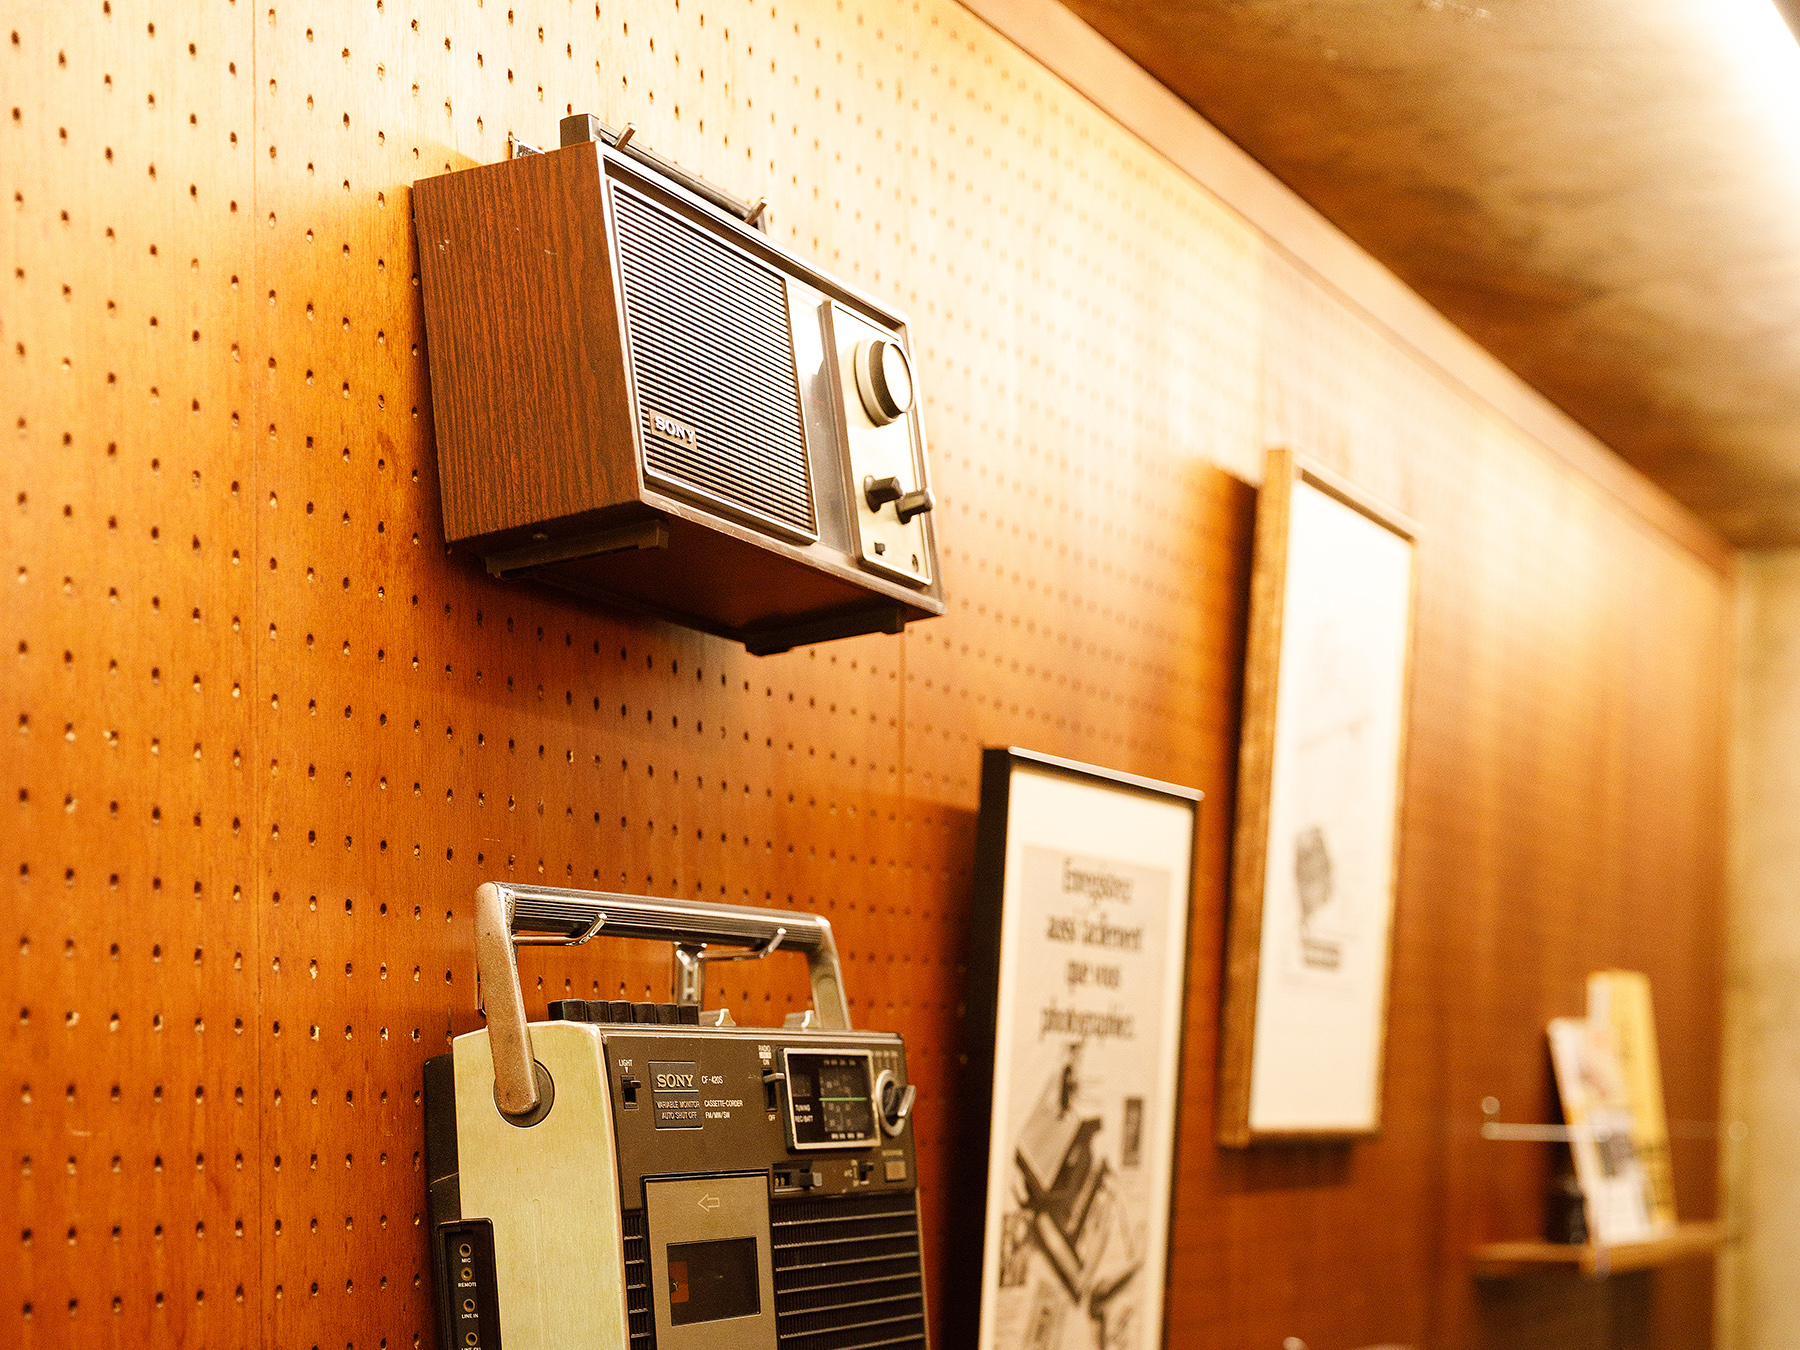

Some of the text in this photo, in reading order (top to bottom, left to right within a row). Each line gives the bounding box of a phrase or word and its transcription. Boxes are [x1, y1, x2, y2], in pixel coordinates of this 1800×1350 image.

[654, 415, 695, 444] SONY
[618, 1059, 633, 1067] LIGHT
[656, 1073, 694, 1088] SONY
[679, 1100, 700, 1109] MONITOR
[661, 1111, 675, 1120] AUTO
[675, 1111, 688, 1120] SHUT
